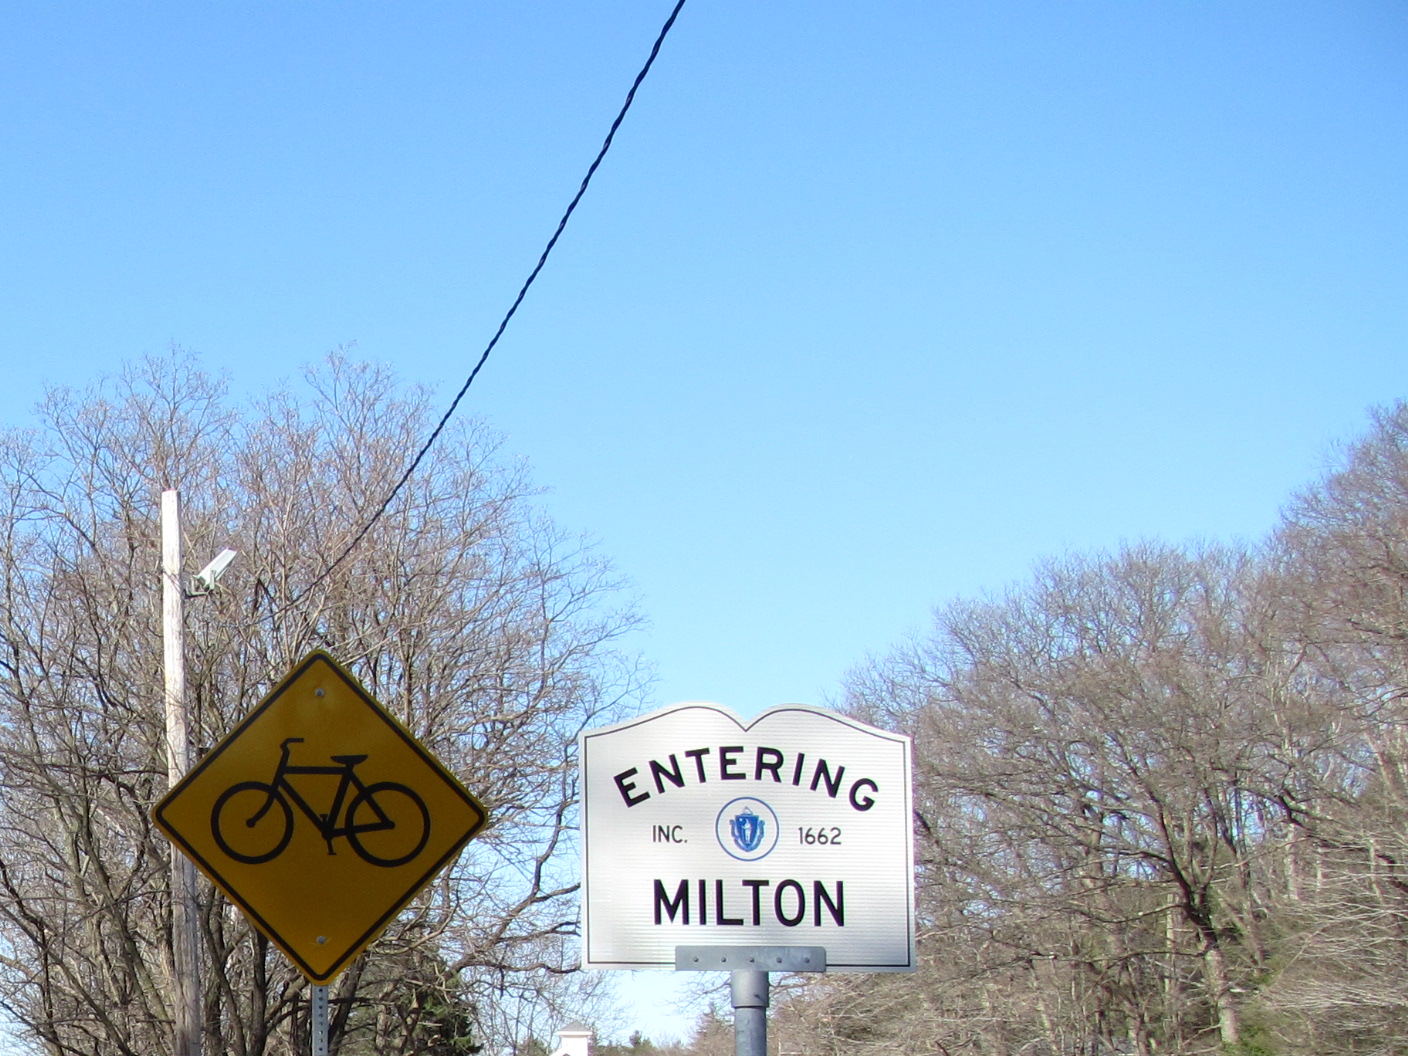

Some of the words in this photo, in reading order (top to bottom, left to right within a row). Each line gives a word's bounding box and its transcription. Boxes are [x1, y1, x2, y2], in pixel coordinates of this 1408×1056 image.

[613, 745, 879, 812] ENTERING
[652, 824, 688, 844] INC.
[798, 826, 842, 846] 1662
[653, 878, 845, 927] MILTON
